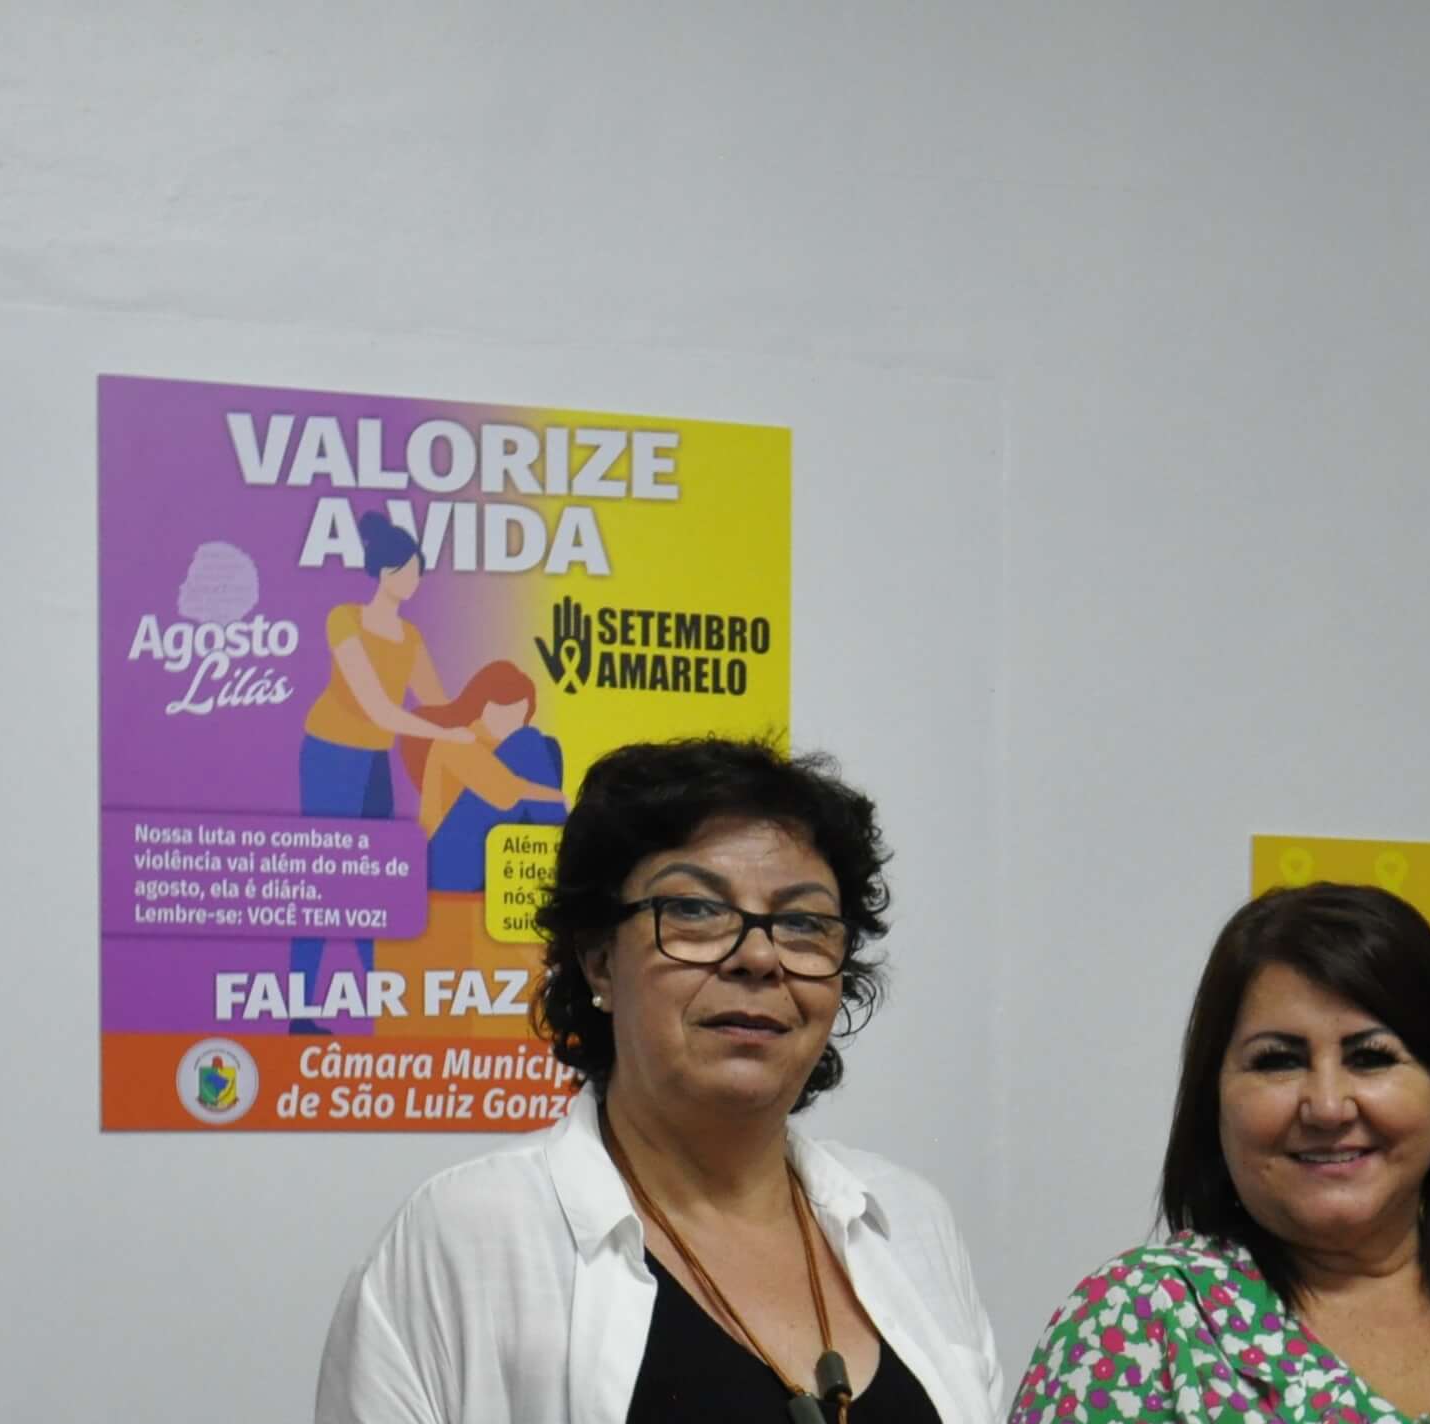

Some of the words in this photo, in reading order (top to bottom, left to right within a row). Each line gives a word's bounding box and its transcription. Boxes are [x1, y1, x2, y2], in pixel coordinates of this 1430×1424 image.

[226, 412, 680, 500] VALORIZE
[298, 497, 366, 569] A
[387, 500, 612, 577] VIDA
[128, 614, 300, 673] Agosto
[597, 607, 771, 655] SETEMBRO
[165, 651, 295, 715] Lilás
[596, 651, 748, 696] AMARELO
[135, 824, 192, 844] Nossa
[199, 825, 236, 845] luta
[242, 831, 266, 846] no
[271, 828, 353, 849] combate
[358, 833, 370, 850] a
[503, 835, 548, 854] Além
[134, 849, 221, 871] violência
[227, 852, 255, 872] vai
[260, 853, 306, 874] além
[312, 855, 336, 875] do
[342, 856, 380, 876] mês
[385, 858, 409, 877] de
[503, 860, 513, 879] é
[520, 861, 556, 879] idea
[135, 879, 205, 900] agosto,
[210, 878, 239, 899] ela
[245, 879, 256, 898] é
[262, 879, 322, 900] diária.
[503, 886, 535, 905] nós
[135, 903, 242, 925] Lembre-se:
[247, 903, 296, 926] VOCÊ
[302, 907, 341, 927] TEM
[345, 909, 387, 928] VOZ!
[216, 970, 407, 1020] FALAR
[424, 969, 529, 1016] FAZ
[300, 1042, 432, 1079] Câmara
[442, 1044, 576, 1088] Municip
[277, 1085, 319, 1119] de
[329, 1084, 397, 1119] São
[405, 1084, 474, 1118] Luiz
[482, 1087, 571, 1120] Gonz
